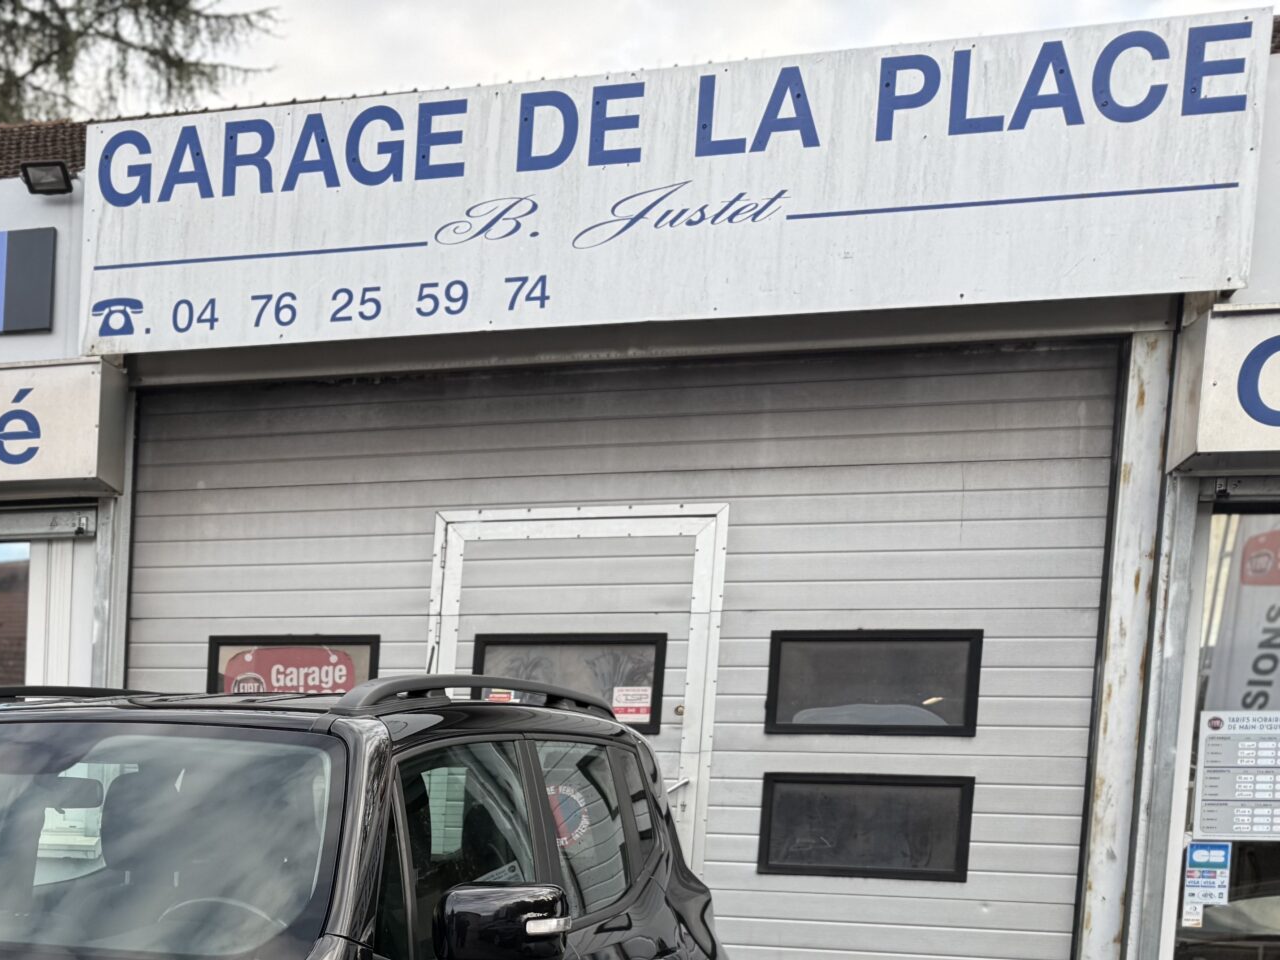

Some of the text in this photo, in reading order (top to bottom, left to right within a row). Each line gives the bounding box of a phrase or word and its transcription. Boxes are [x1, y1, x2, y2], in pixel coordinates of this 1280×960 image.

[98, 21, 1254, 207] GARAGE DE LA PLACE
[433, 179, 791, 250] B. Justet
[171, 274, 551, 334] 04 76 25 59 74
[271, 664, 348, 688] Garage
